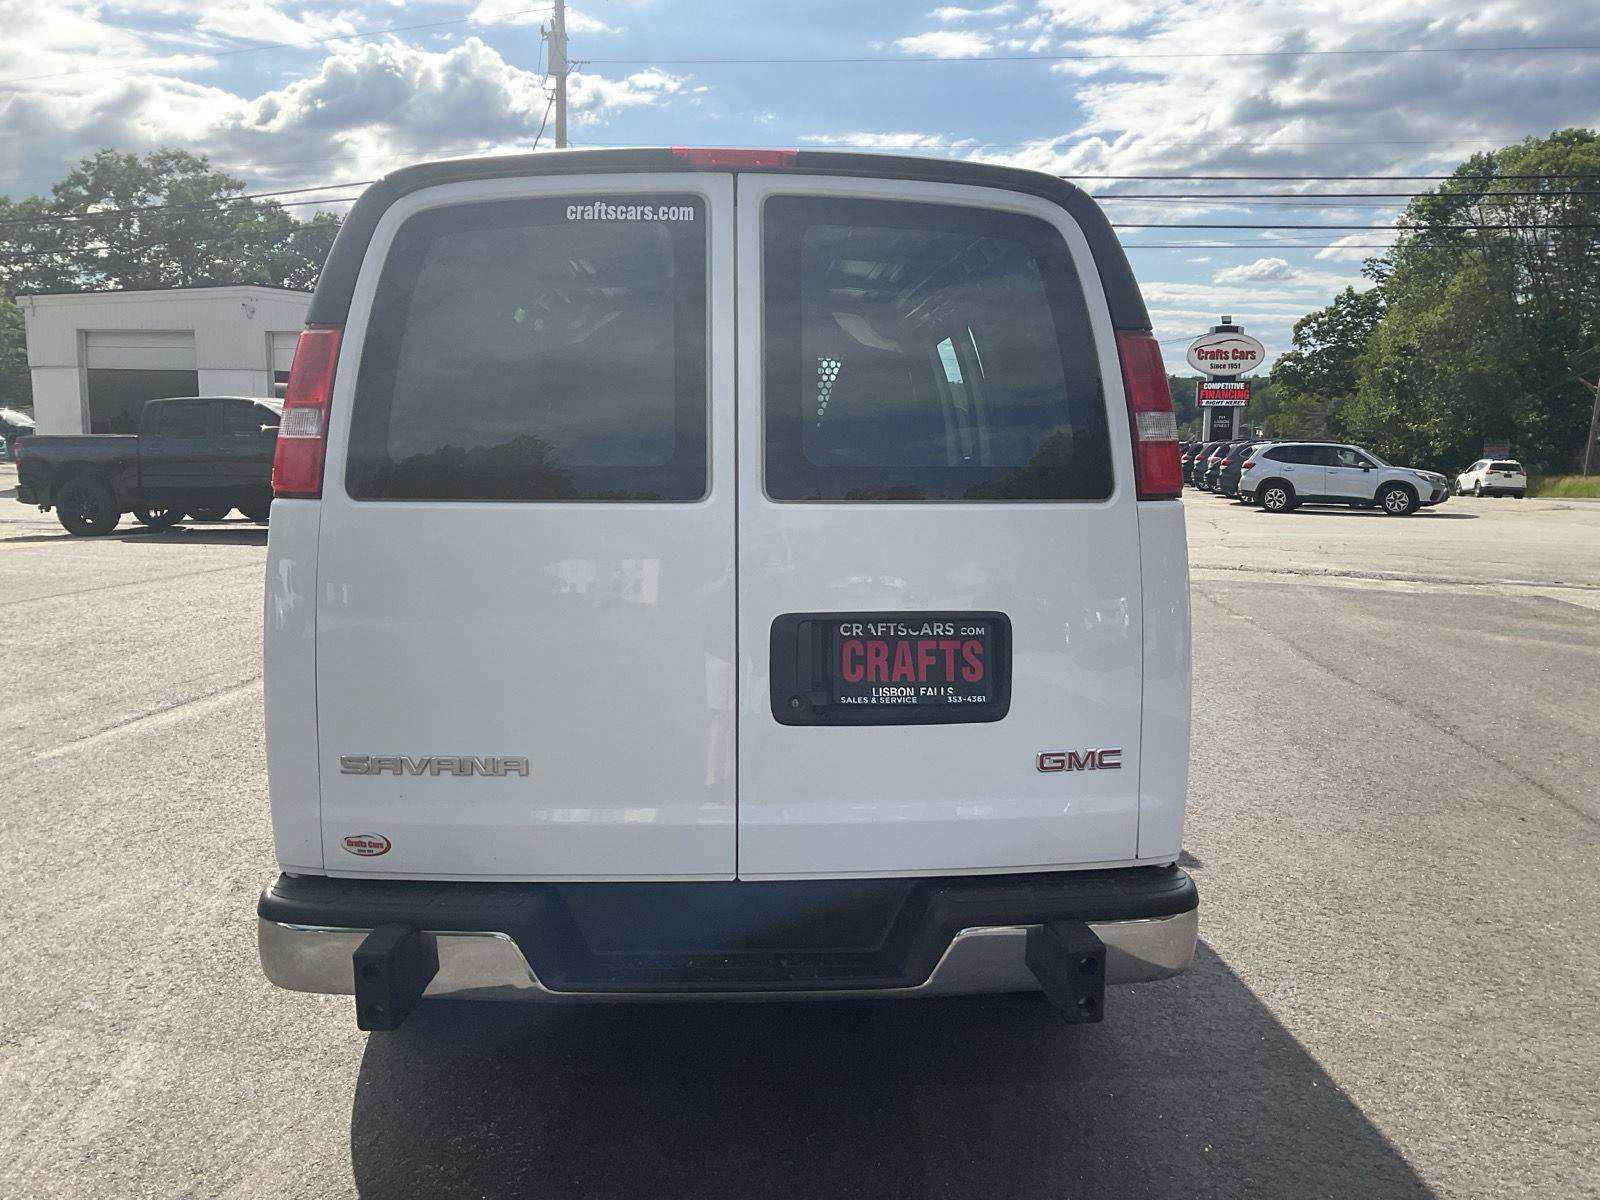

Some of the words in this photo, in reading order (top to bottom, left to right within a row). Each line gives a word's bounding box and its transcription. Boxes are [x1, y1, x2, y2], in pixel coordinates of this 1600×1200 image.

[566, 201, 694, 220] craftscars.com
[1197, 348, 1229, 361] Crafts
[1231, 348, 1256, 361] Cars
[1203, 382, 1245, 390] COMPETITIVE
[1200, 389, 1250, 399] FINANCING
[842, 640, 985, 683] CRAFTS
[872, 687, 914, 697] LISBON
[840, 696, 869, 704] SALES
[871, 696, 877, 704] &
[879, 696, 918, 704] SERVICE
[947, 695, 986, 703] 353-4361
[340, 755, 529, 777] SAVANA
[1036, 747, 1122, 772] GMC
